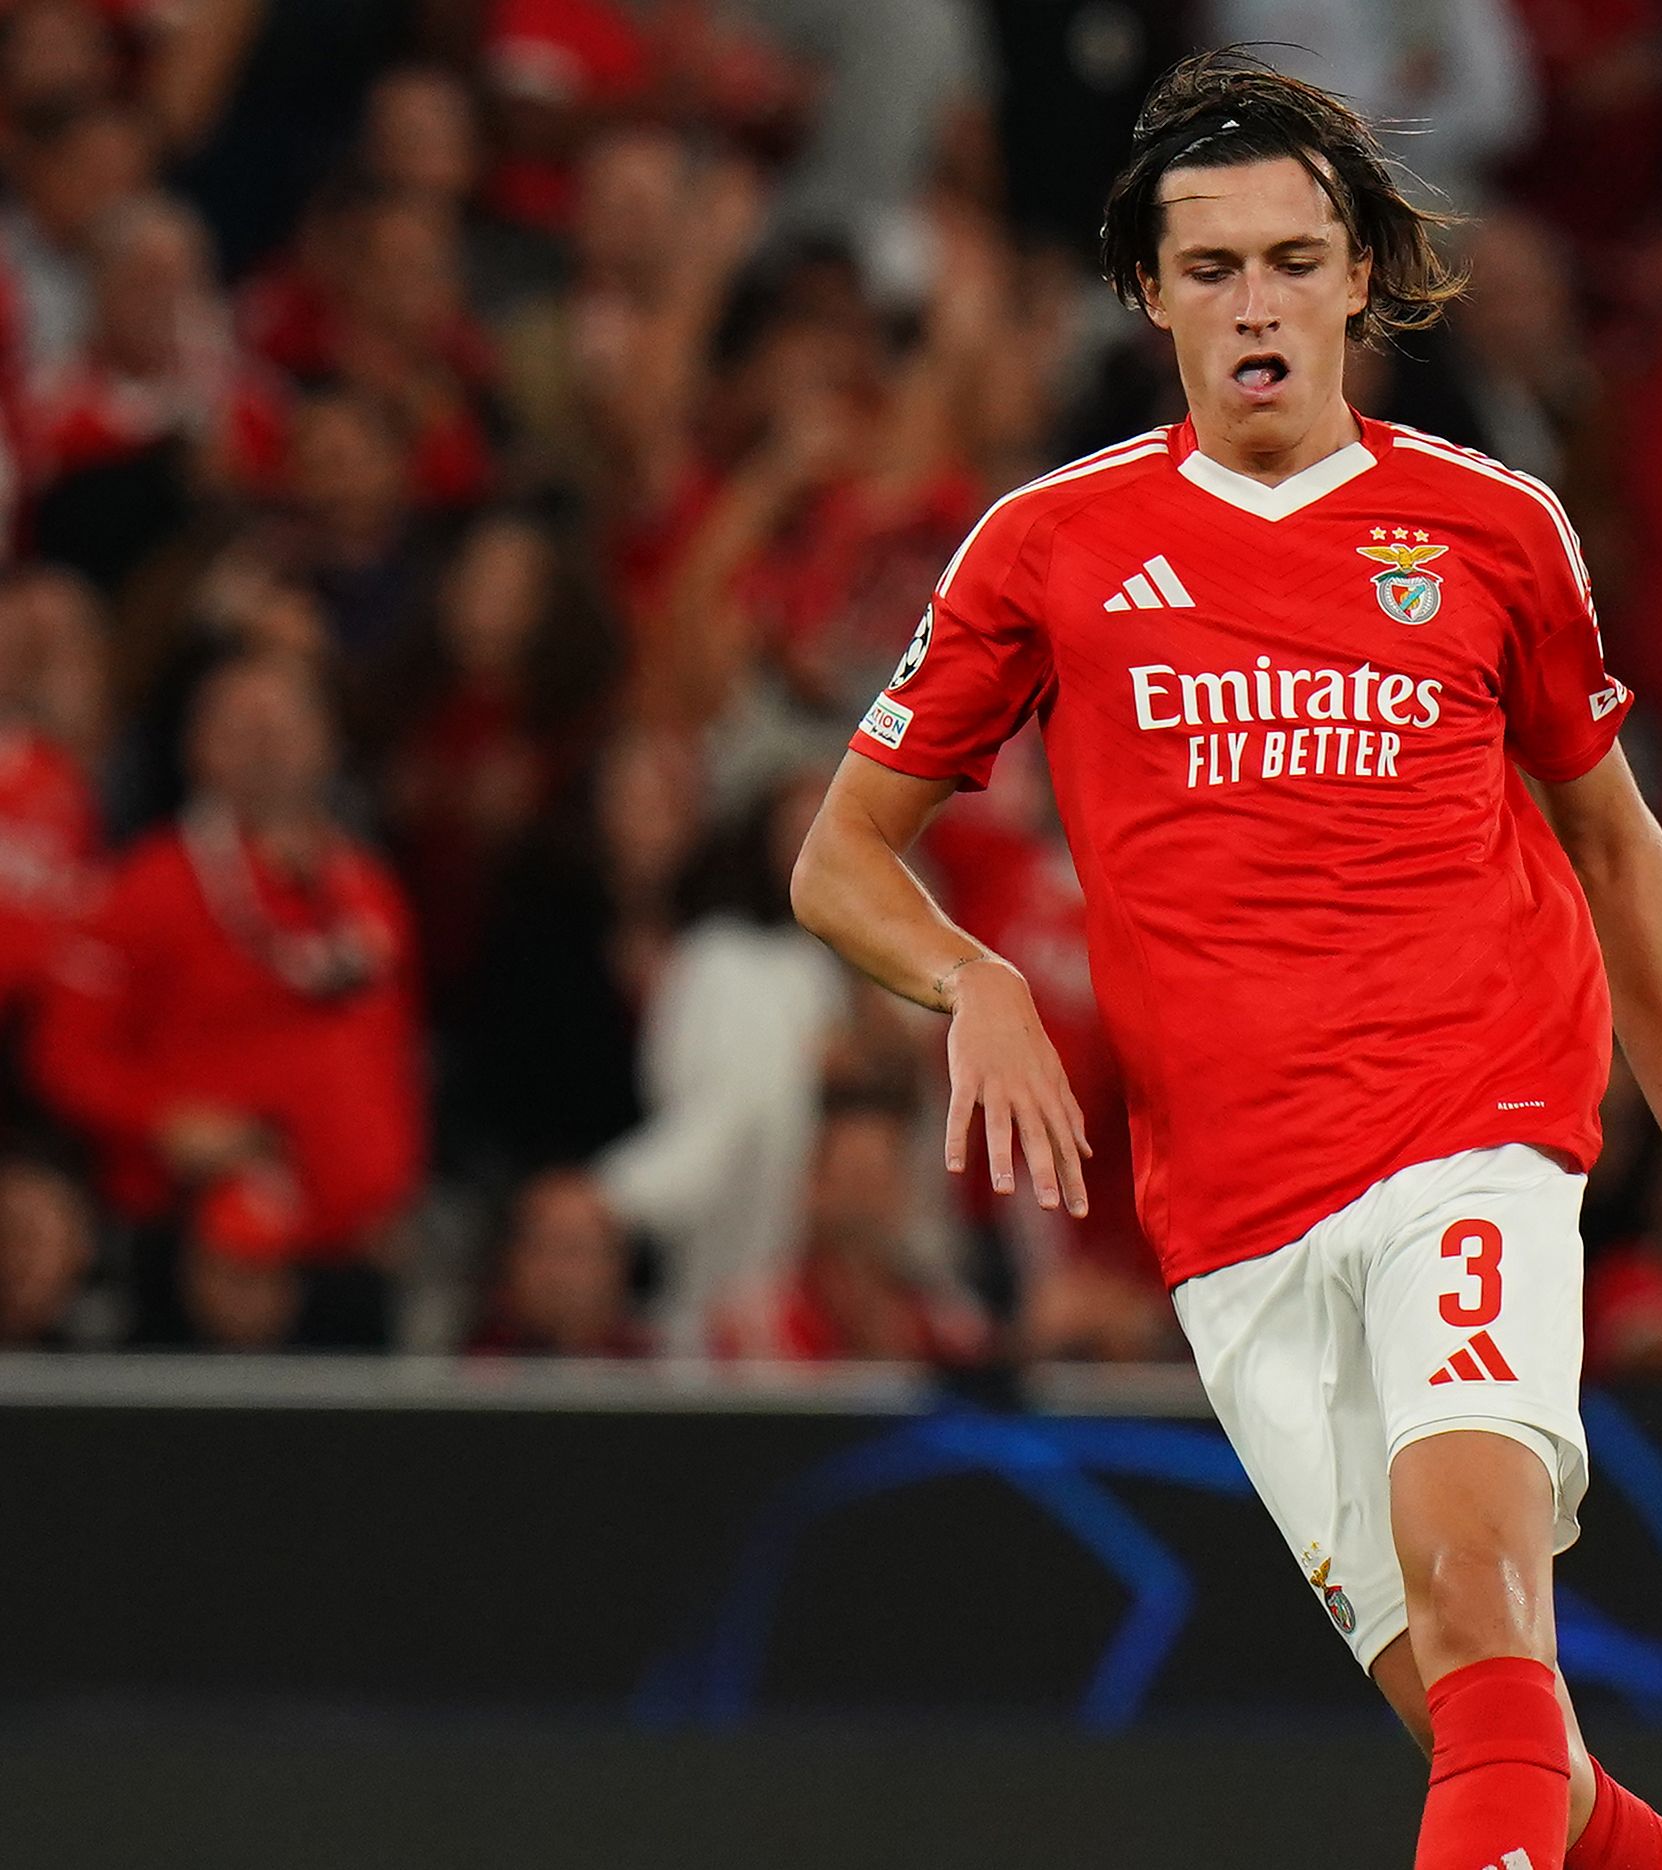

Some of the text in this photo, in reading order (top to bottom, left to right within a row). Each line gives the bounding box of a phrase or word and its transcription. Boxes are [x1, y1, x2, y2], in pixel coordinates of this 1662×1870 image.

[1128, 655, 1443, 731] Emirates
[1187, 726, 1400, 789] FLY BETTER
[1438, 1217, 1504, 1328] 3
